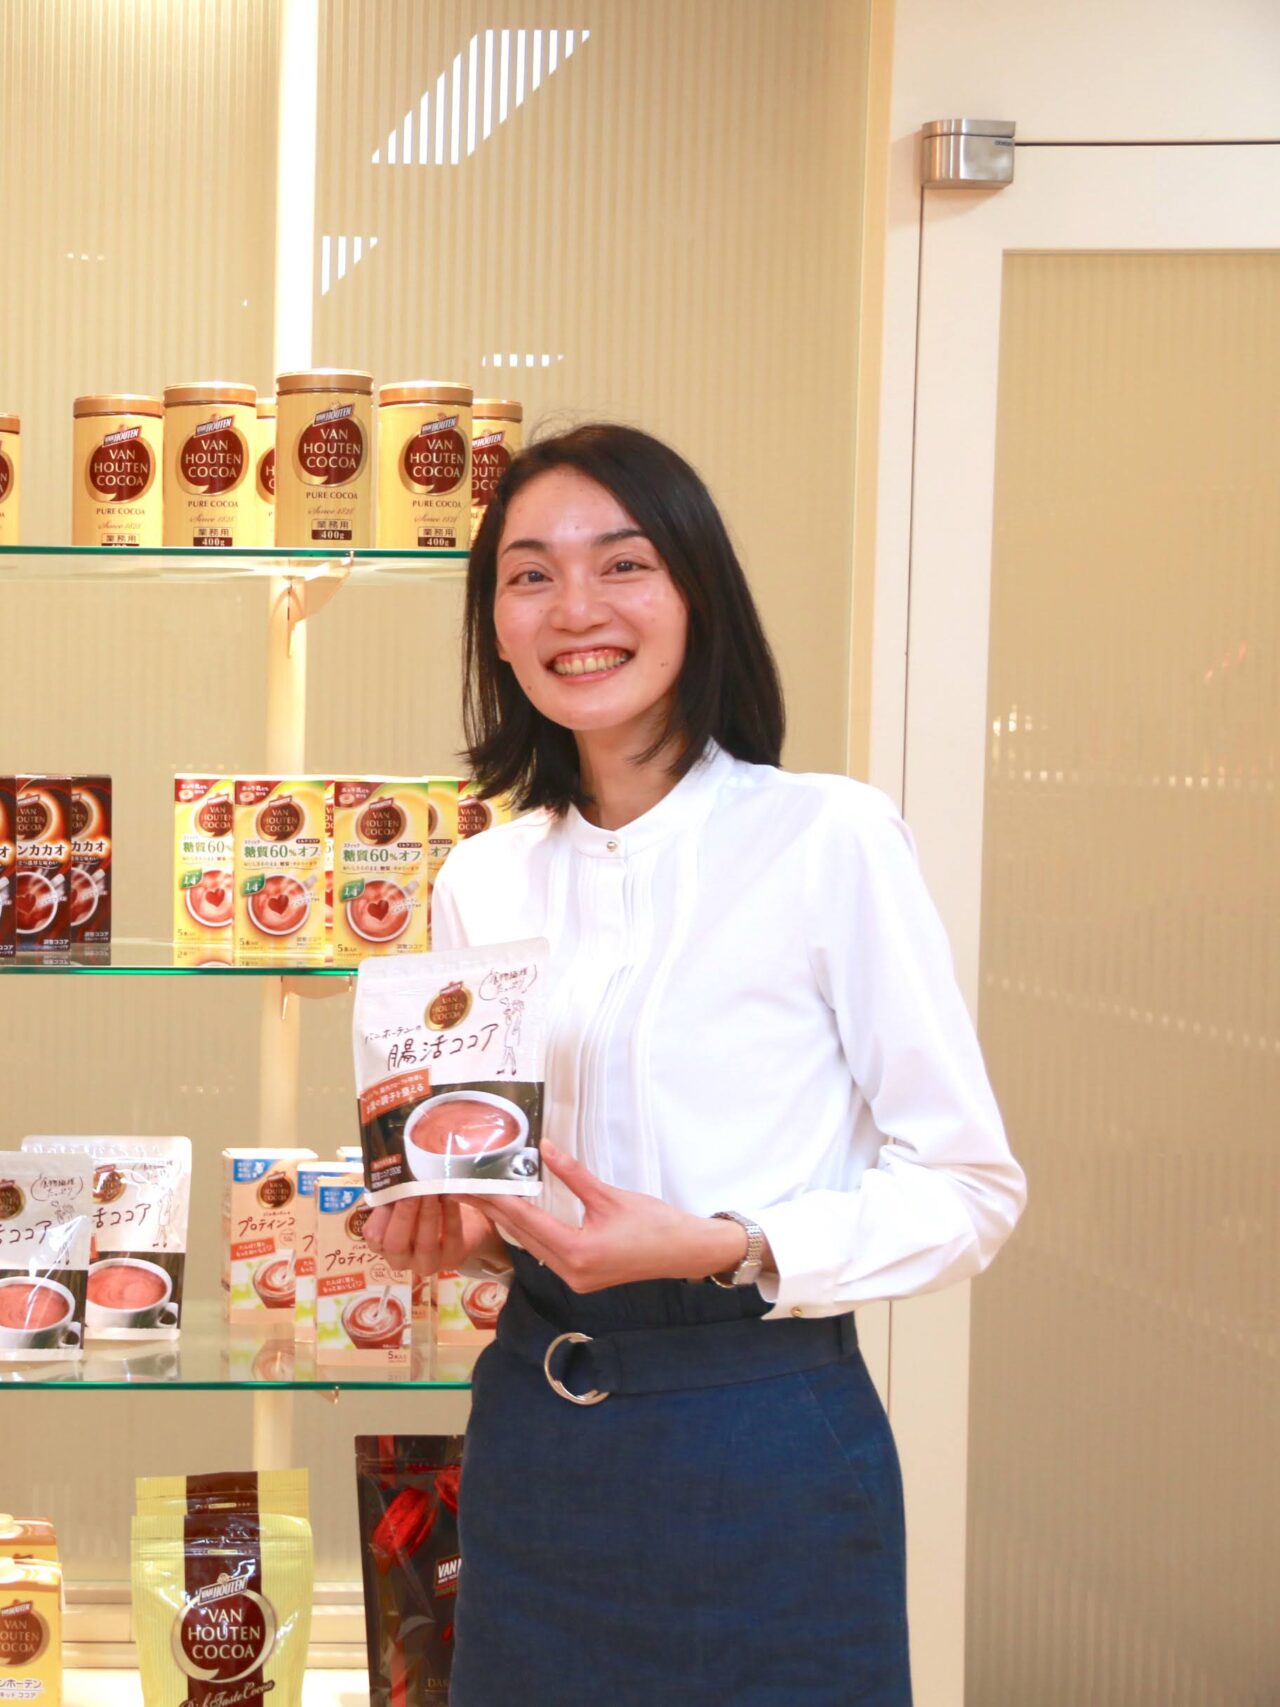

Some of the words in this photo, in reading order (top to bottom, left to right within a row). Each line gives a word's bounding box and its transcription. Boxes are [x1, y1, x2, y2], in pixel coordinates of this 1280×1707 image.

[320, 428, 349, 440] VAN
[201, 439, 229, 450] VAN
[303, 442, 362, 455] HOUTEN
[426, 438, 453, 450] VAN
[109, 449, 136, 460] VAN
[185, 453, 242, 465] HOUTEN
[410, 452, 464, 465] HOUTEN
[472, 454, 499, 465] VAN
[94, 461, 148, 473] HOUTEN
[306, 456, 357, 469] COCOA
[188, 466, 238, 478] COCOA
[413, 466, 461, 479] COCOA
[96, 475, 144, 487] COCOA
[306, 491, 327, 499] PURE
[329, 491, 358, 500] COCOA
[412, 500, 433, 508] PURE
[435, 500, 461, 508] COCOA
[317, 521, 350, 529] 業務用
[198, 528, 230, 537] 業務用
[320, 530, 345, 540] 400g
[423, 528, 454, 537] 業務用
[106, 535, 137, 543] 業務用
[202, 537, 226, 547] 400g
[426, 537, 450, 547] 400g
[272, 808, 289, 816] VAN
[371, 811, 390, 819] VAN
[264, 825, 294, 833] COCOA
[364, 820, 400, 828] HOUTEN
[365, 828, 396, 836] COCOA
[17, 845, 66, 856] ンカカオ
[72, 841, 106, 852] カカオ
[244, 844, 320, 858] 糖質60%オフ
[343, 849, 421, 862] 糖質60%オフ
[387, 1023, 498, 1071] 腸活ココア
[325, 1249, 385, 1271] プロテイン
[212, 1580, 246, 1598] HOUTEN
[207, 1608, 243, 1623] VAN
[3, 1620, 28, 1630] VAN
[187, 1626, 261, 1641] HOUTEN
[192, 1644, 255, 1660] COCOA
[210, 1689, 243, 1707] Taste
